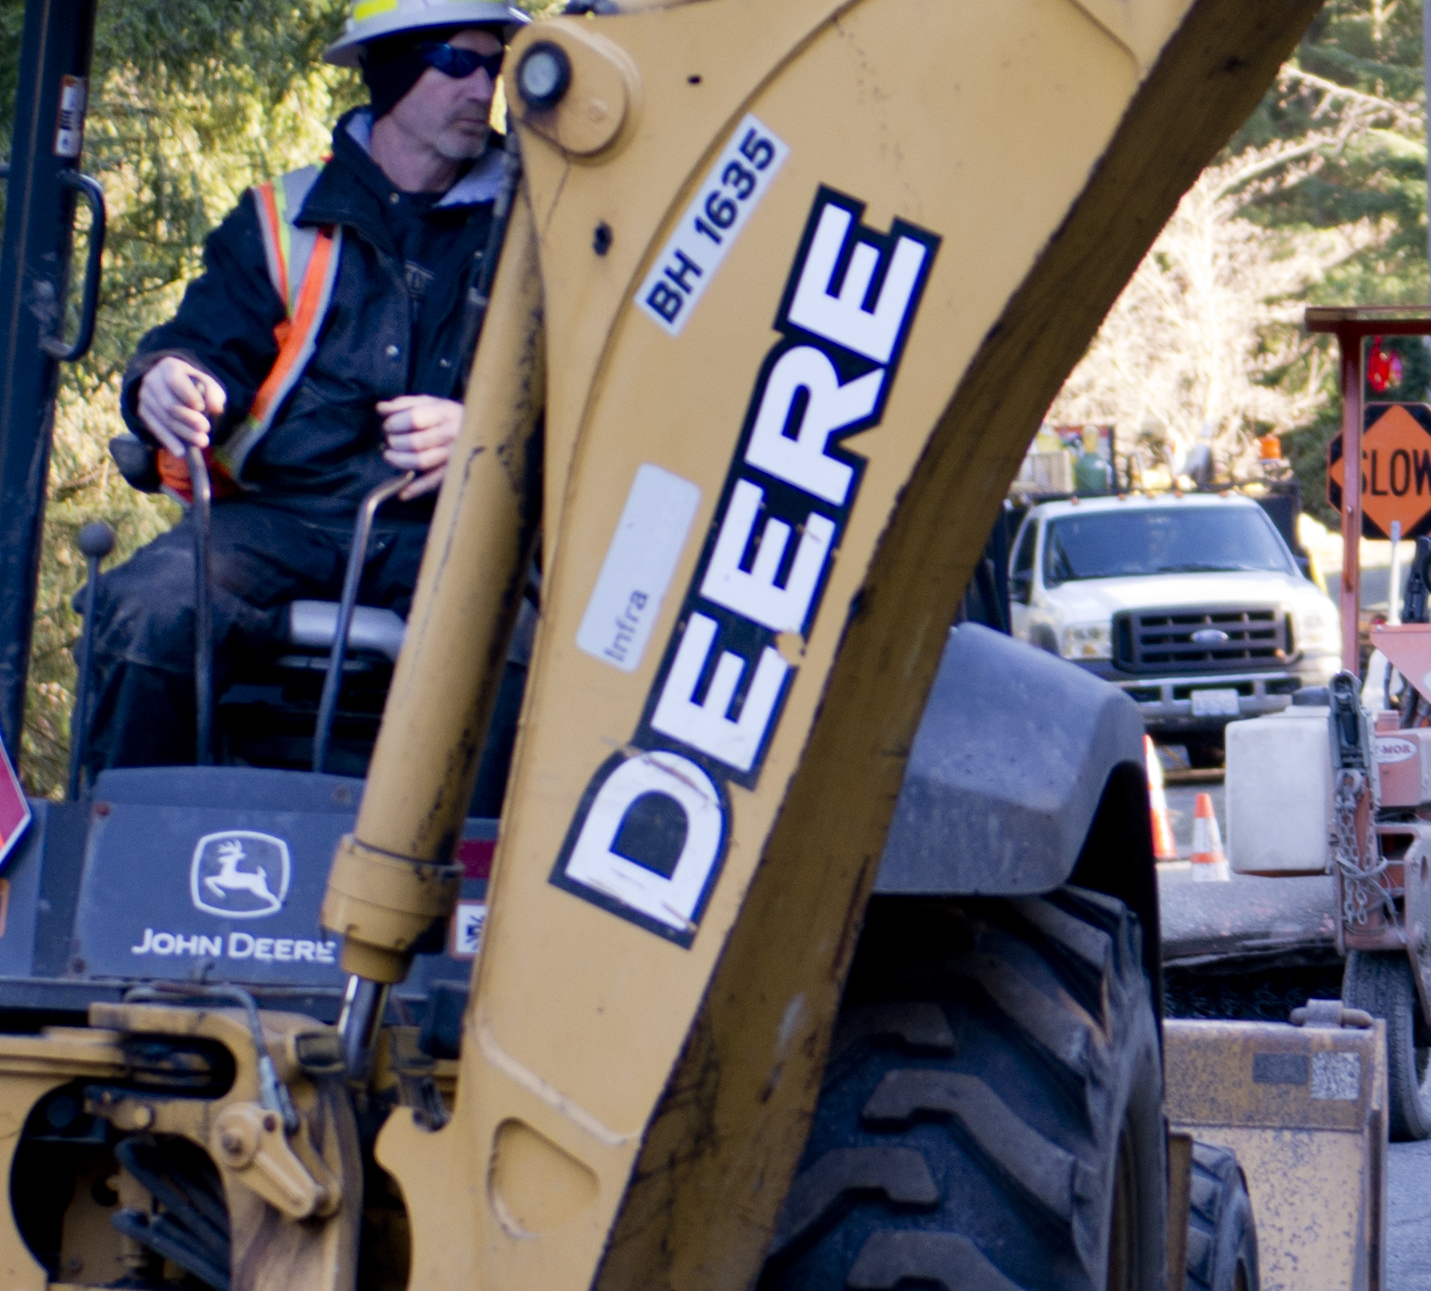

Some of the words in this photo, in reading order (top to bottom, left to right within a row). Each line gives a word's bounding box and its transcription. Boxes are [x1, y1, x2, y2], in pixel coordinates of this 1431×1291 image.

[646, 248, 704, 324] BH
[694, 127, 776, 245] 1635
[564, 200, 929, 935] DEERE
[603, 589, 649, 662] Infra
[131, 927, 222, 957] JOHN
[227, 931, 337, 963] DEERE
